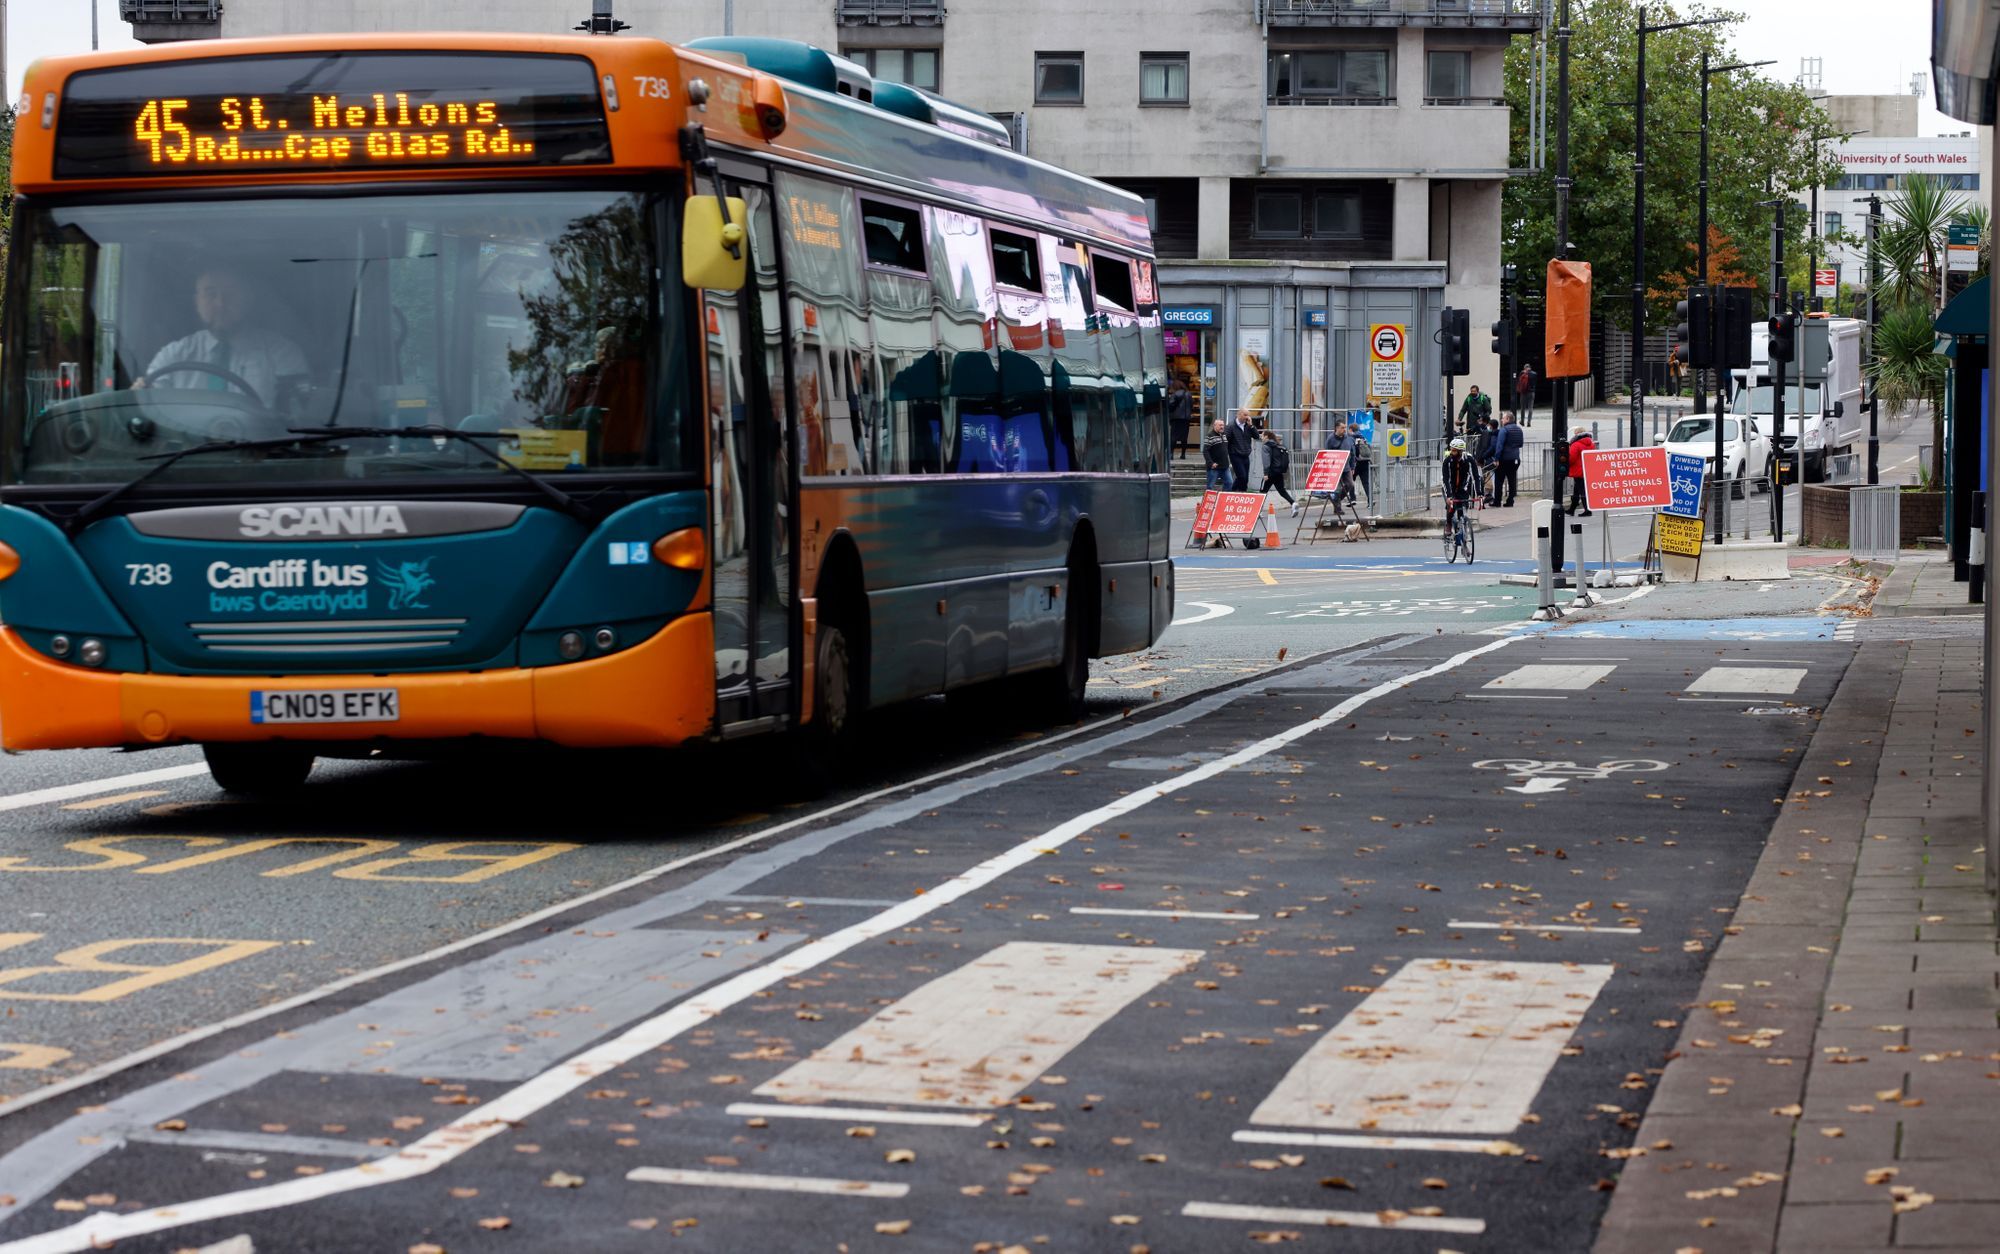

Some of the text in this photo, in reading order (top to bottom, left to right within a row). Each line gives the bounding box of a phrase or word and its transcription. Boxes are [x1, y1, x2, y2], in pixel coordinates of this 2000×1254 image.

[633, 76, 671, 99] 738
[221, 94, 496, 130] St. Mellons
[136, 100, 191, 162] 45
[367, 132, 450, 156] Glas
[1836, 153, 1967, 166] University of South Wales
[1164, 311, 1210, 321] GREGGS
[1595, 451, 1652, 461] ARWYDDION
[1675, 456, 1700, 465] DIWEDD
[1611, 460, 1638, 468] BEICS
[1677, 464, 1702, 473] LLWYBR
[1620, 468, 1647, 476] WAITH
[1591, 478, 1663, 489] CYCLE SIGNALS
[1225, 495, 1255, 504] FFORDD
[1603, 495, 1655, 505] OPERATION
[1224, 505, 1234, 513] AR
[239, 505, 408, 537] SCANIA
[1218, 523, 1245, 531] CLOSED
[1661, 538, 1692, 547] CYCLISTS
[1661, 544, 1693, 553] ISMOUNT
[125, 563, 172, 585] 738
[207, 559, 368, 588] Cardiff bus
[209, 590, 368, 614] bws Caerdydd
[268, 692, 394, 718] CN09 EFK
